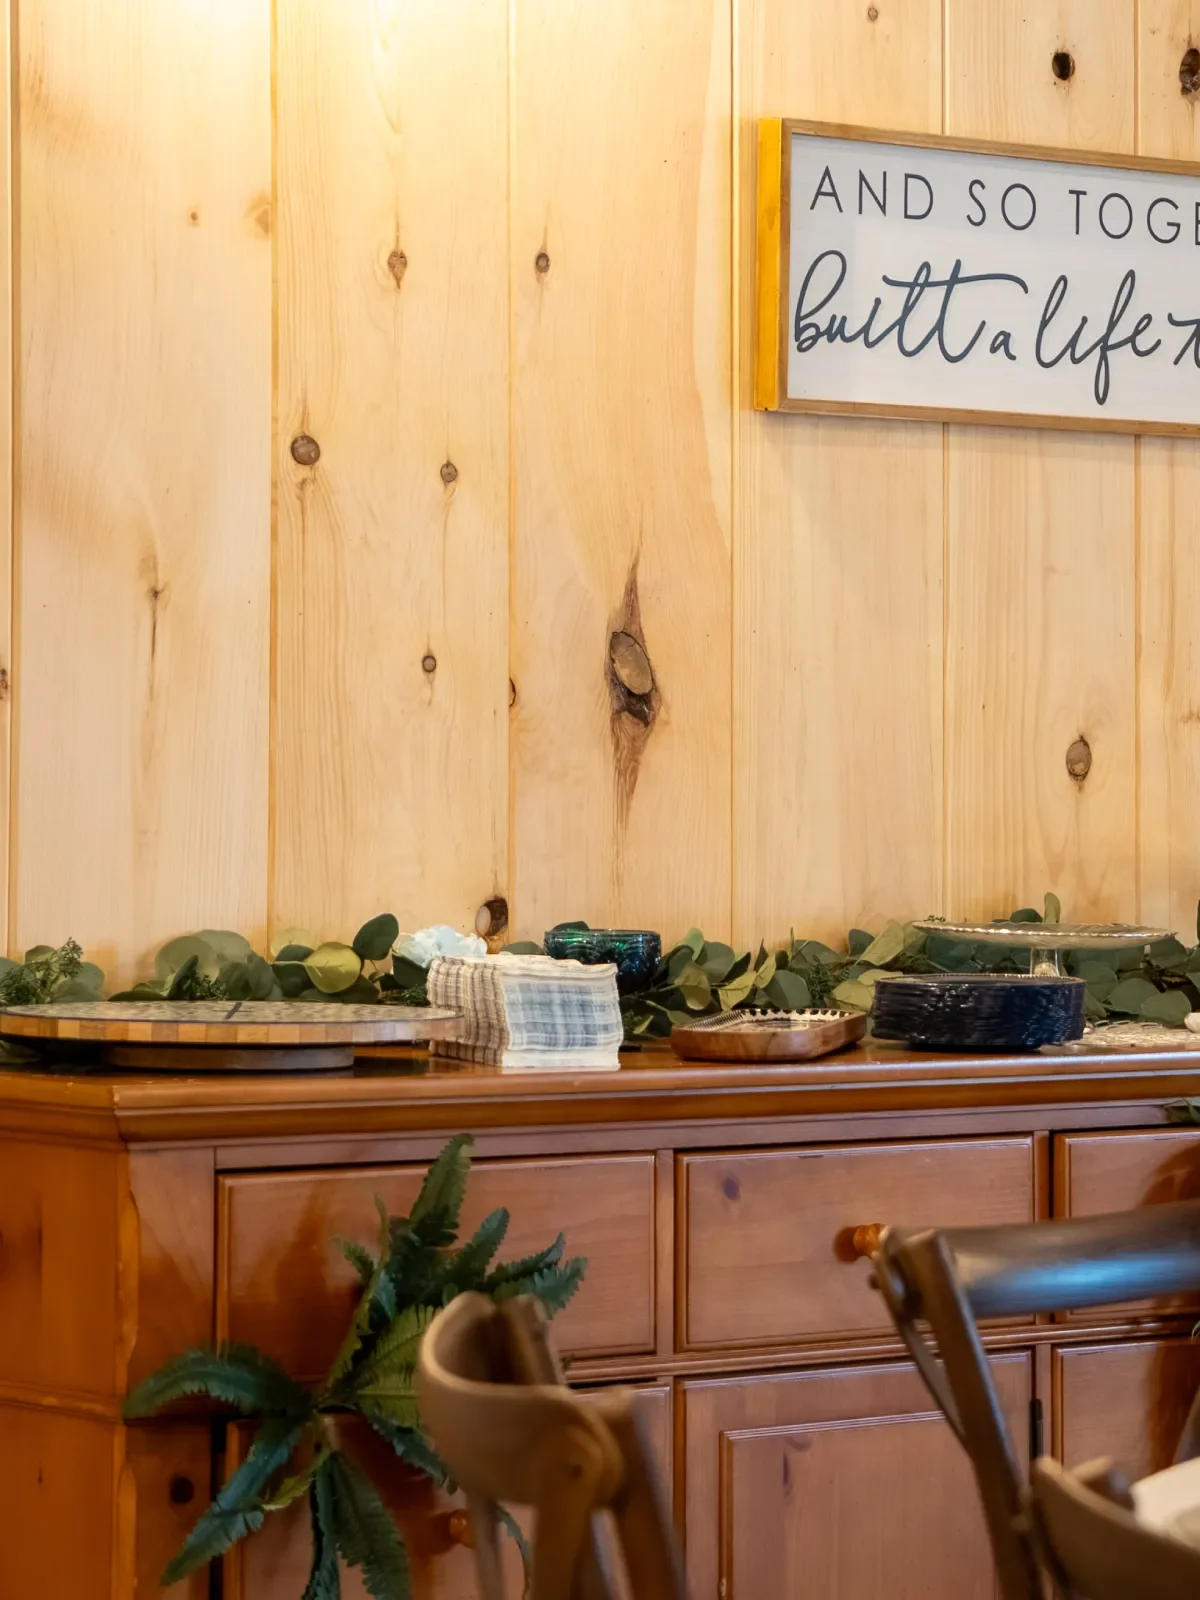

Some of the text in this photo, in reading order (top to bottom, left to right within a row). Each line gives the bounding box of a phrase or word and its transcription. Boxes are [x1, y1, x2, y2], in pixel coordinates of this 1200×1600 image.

[809, 165, 935, 220] AND
[966, 179, 1037, 231] SO
[794, 249, 1029, 363] built
[989, 329, 1017, 361] a
[1035, 269, 1162, 405] life
